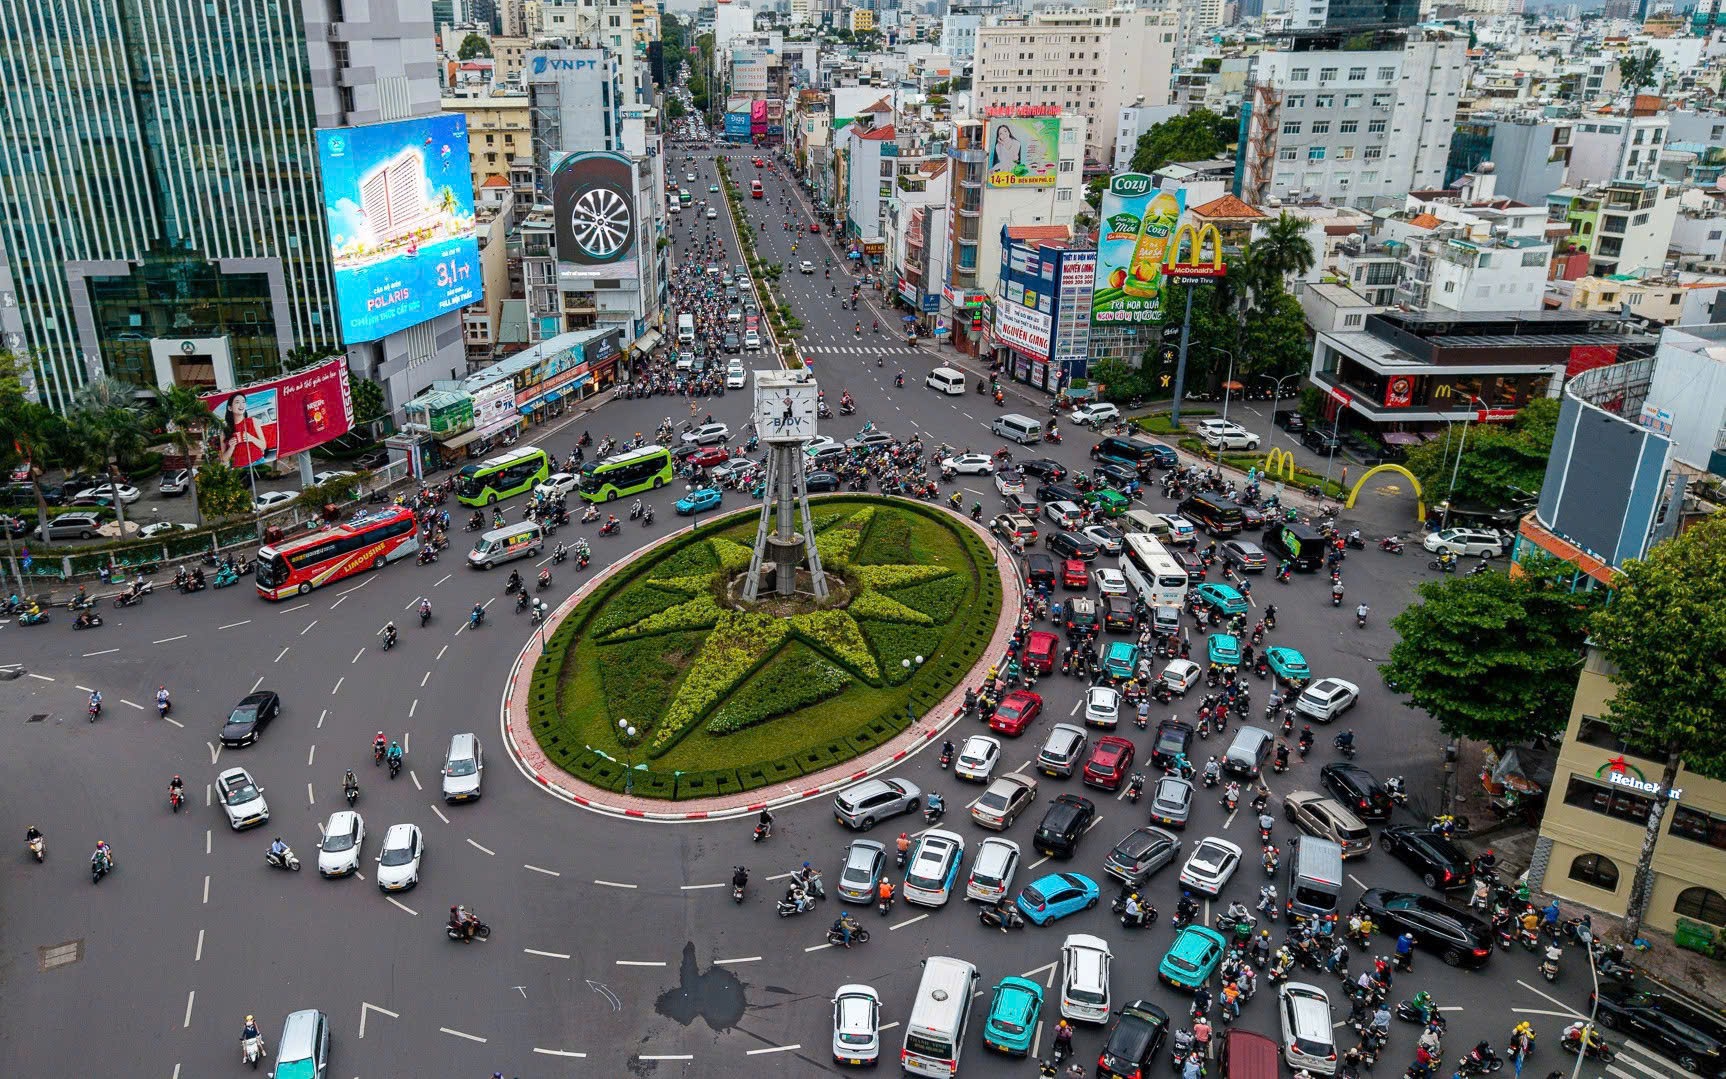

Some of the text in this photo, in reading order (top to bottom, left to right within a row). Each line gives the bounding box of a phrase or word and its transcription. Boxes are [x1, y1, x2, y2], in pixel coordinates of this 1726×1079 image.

[550, 60, 597, 71] VNPT
[991, 175, 1016, 184] 14-16
[1115, 178, 1148, 192] Cozy
[1146, 225, 1168, 237] Cozy
[436, 260, 457, 288] 3,1
[1081, 264, 1094, 272] GIANG
[367, 288, 409, 311] POLARIS
[1111, 298, 1124, 309] TRÀ
[1127, 301, 1141, 309] HOA
[1029, 333, 1048, 349] GIANG
[503, 399, 514, 411] 7K
[774, 417, 801, 426] BDV
[344, 541, 386, 573] LIMOUSINE
[1610, 772, 1680, 799] Heinekn
